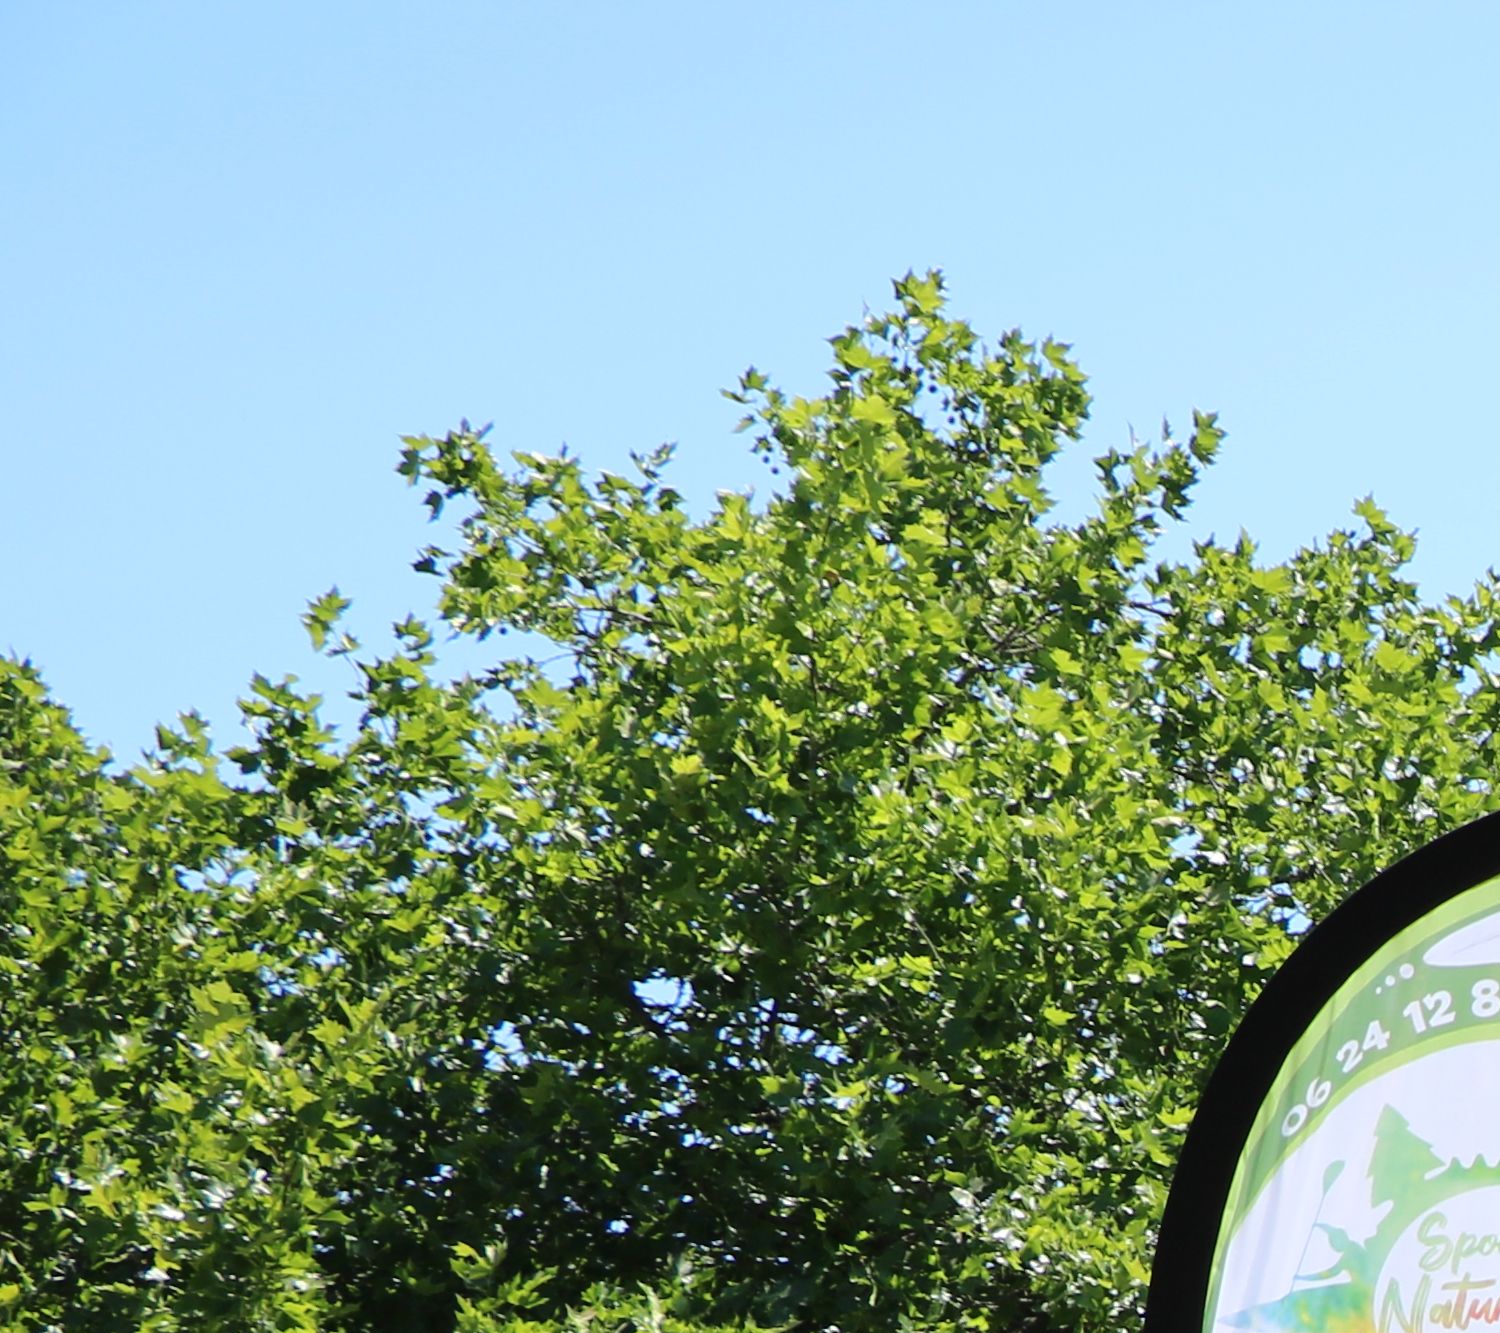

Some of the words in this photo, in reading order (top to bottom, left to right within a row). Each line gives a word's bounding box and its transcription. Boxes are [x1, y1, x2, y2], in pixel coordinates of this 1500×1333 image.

[1281, 1077, 1332, 1137] 06
[1335, 1019, 1390, 1073] 24
[1402, 990, 1456, 1034] 12
